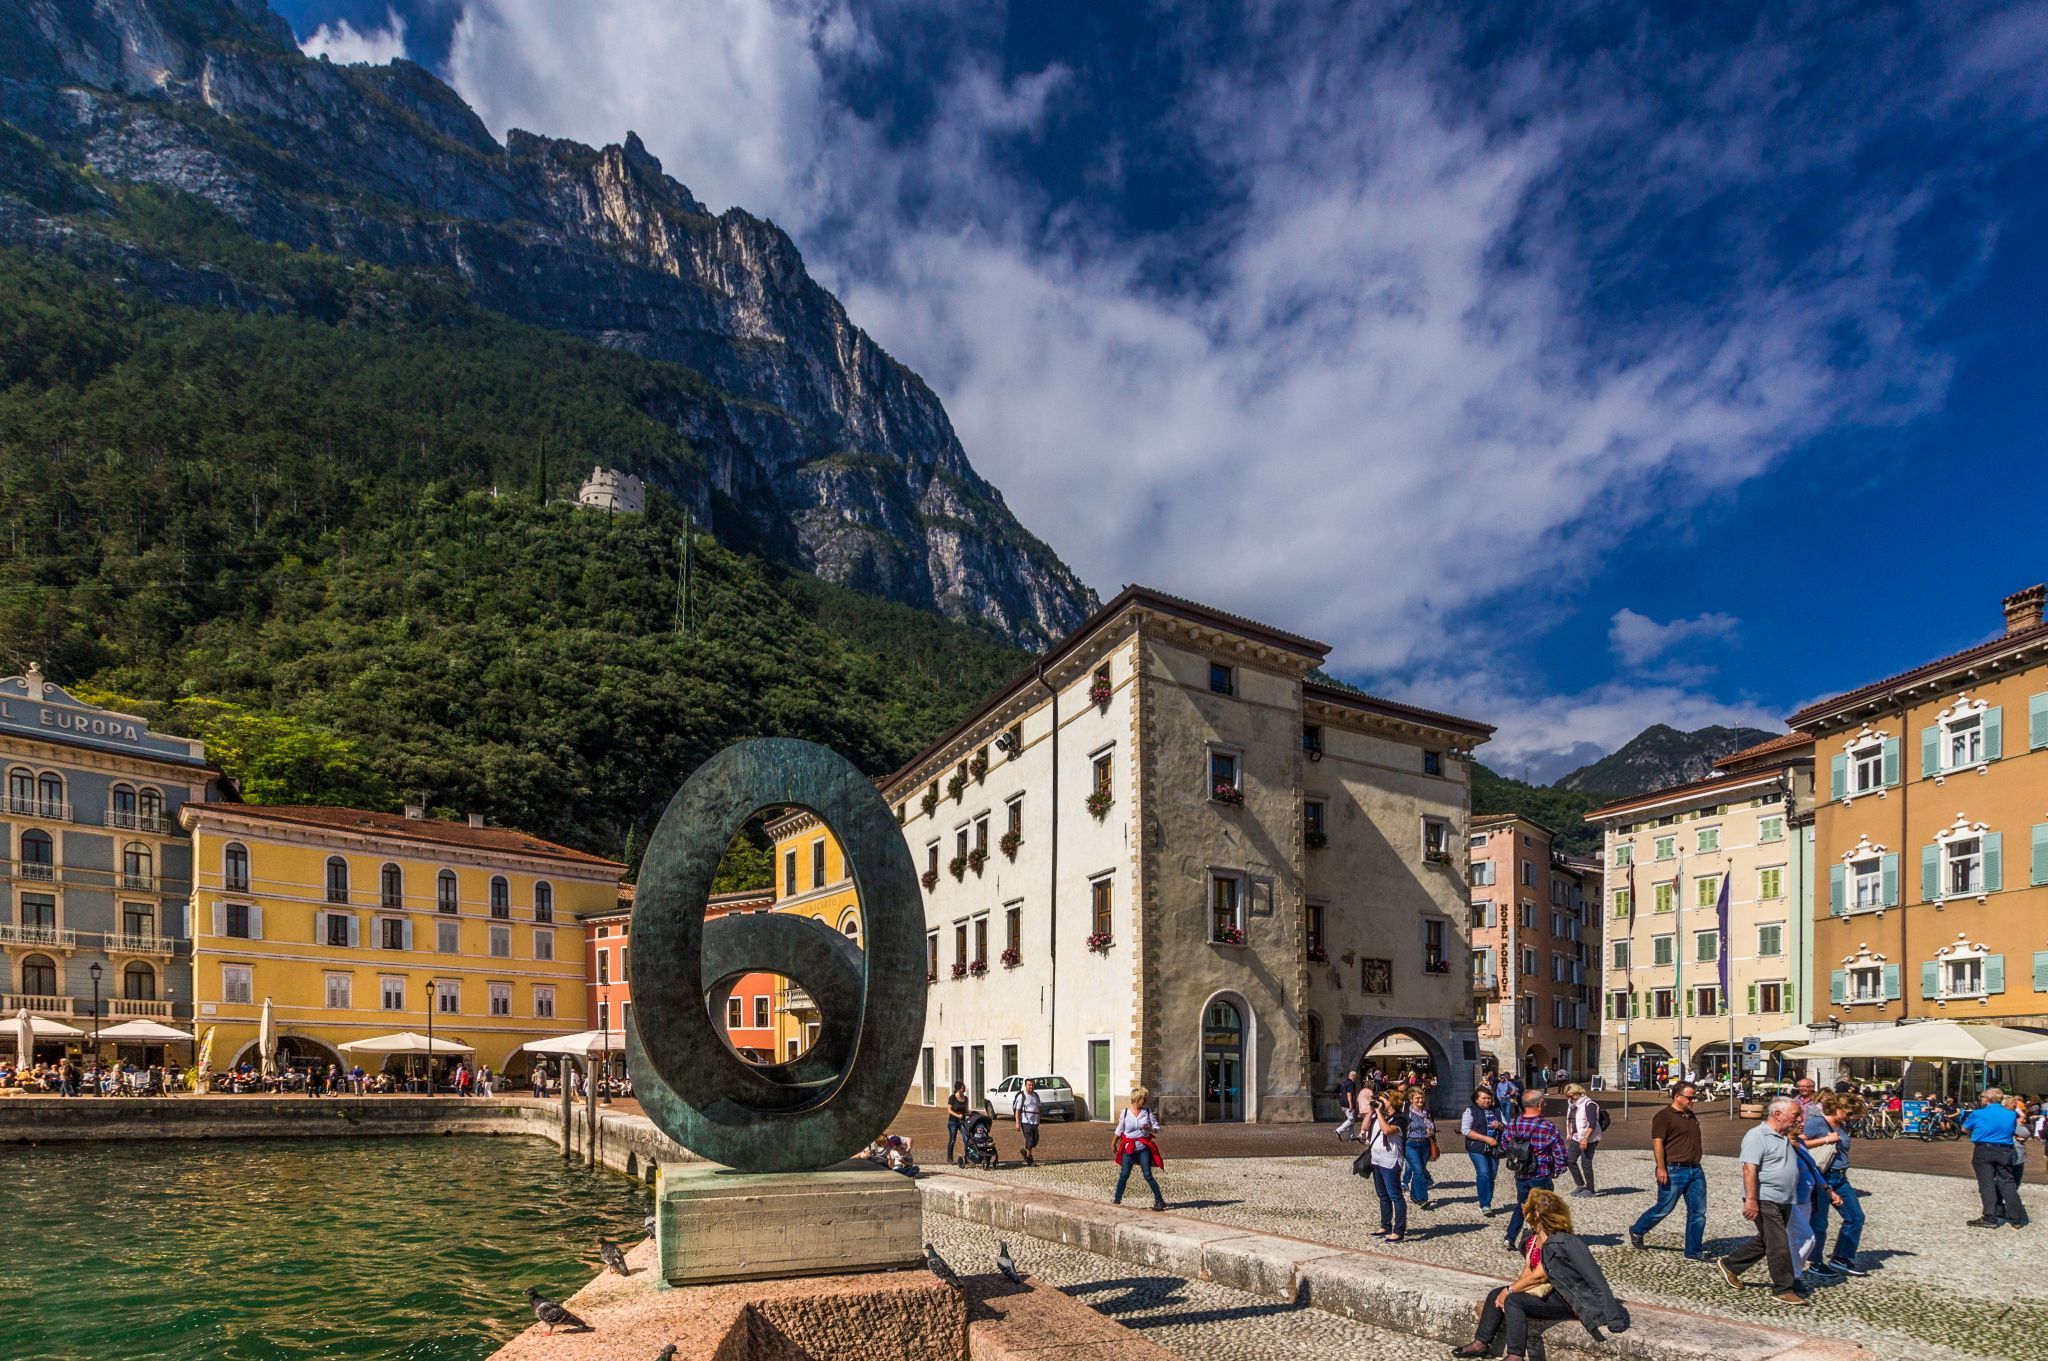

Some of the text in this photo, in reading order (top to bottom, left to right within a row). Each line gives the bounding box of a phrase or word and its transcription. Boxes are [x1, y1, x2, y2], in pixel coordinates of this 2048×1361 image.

[39, 708, 138, 741] EUROPA
[1500, 904, 1508, 992] HOTEL PORTICI
